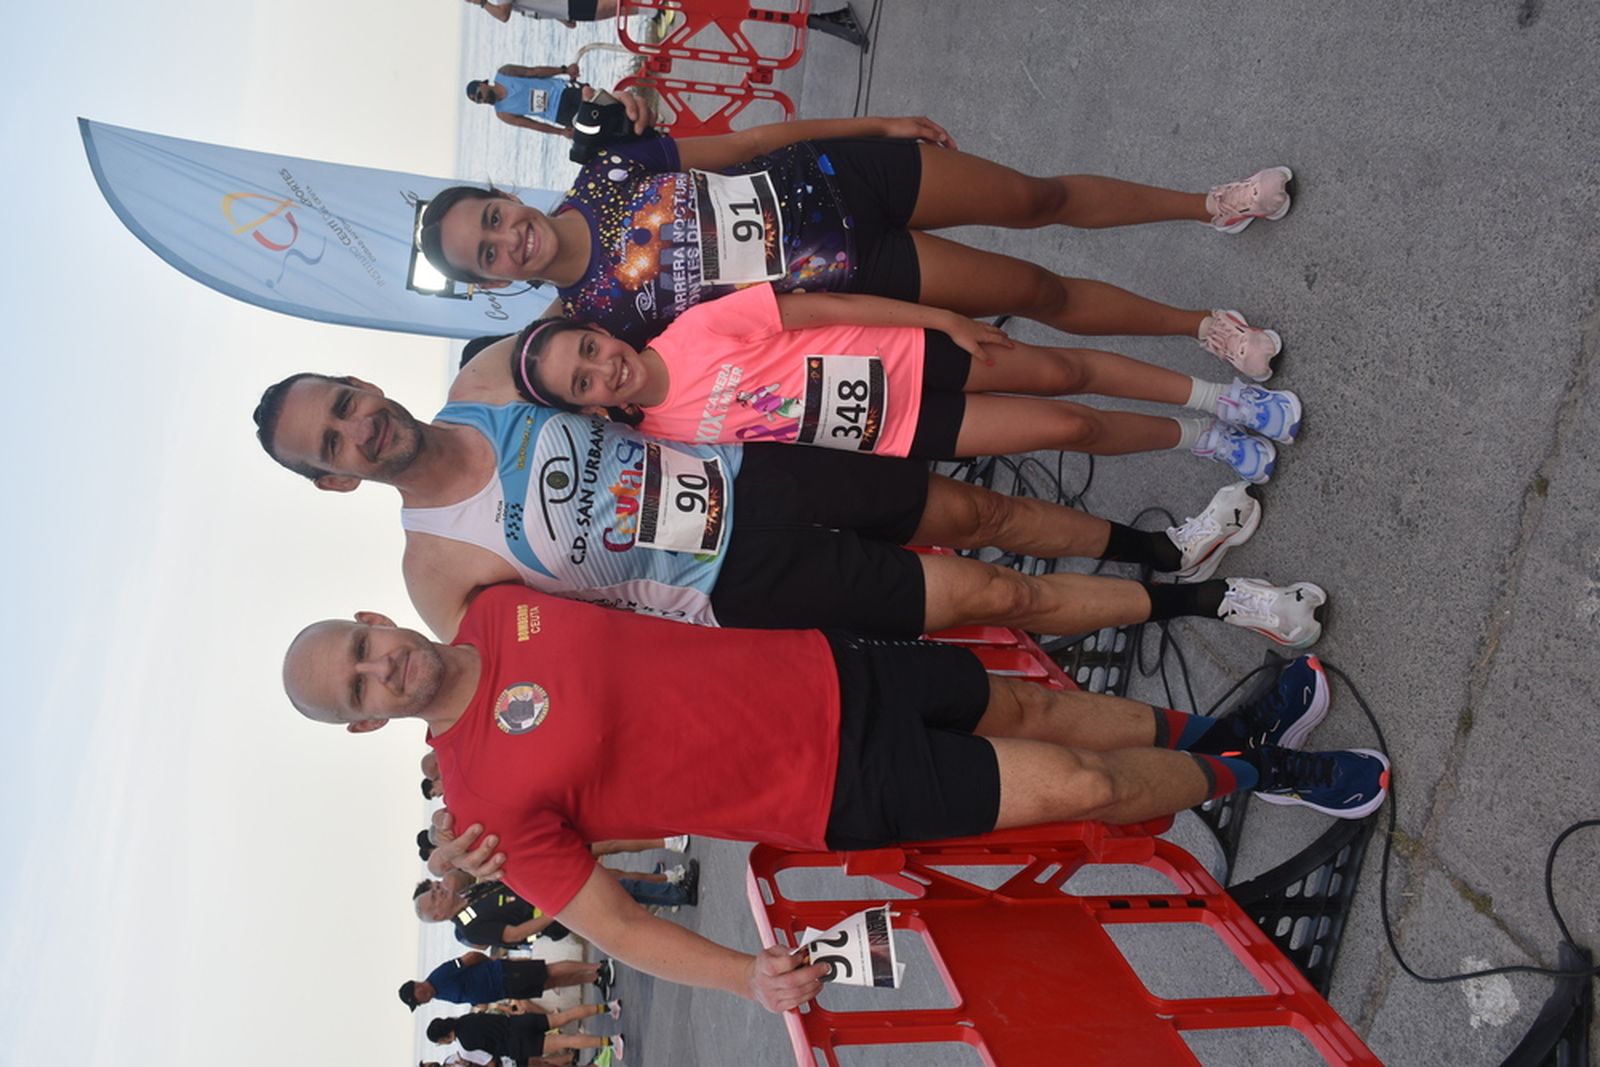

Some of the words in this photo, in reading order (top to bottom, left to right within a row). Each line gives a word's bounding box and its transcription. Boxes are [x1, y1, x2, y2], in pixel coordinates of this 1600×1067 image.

[687, 219, 699, 243] DE
[728, 198, 763, 242] 91
[672, 247, 687, 314] ARRERA
[693, 410, 728, 443] XIX
[831, 380, 869, 440] 348
[576, 490, 594, 527] SAN
[675, 473, 708, 514] 90
[570, 532, 588, 565] C.D.
[529, 605, 541, 634] CEUTA
